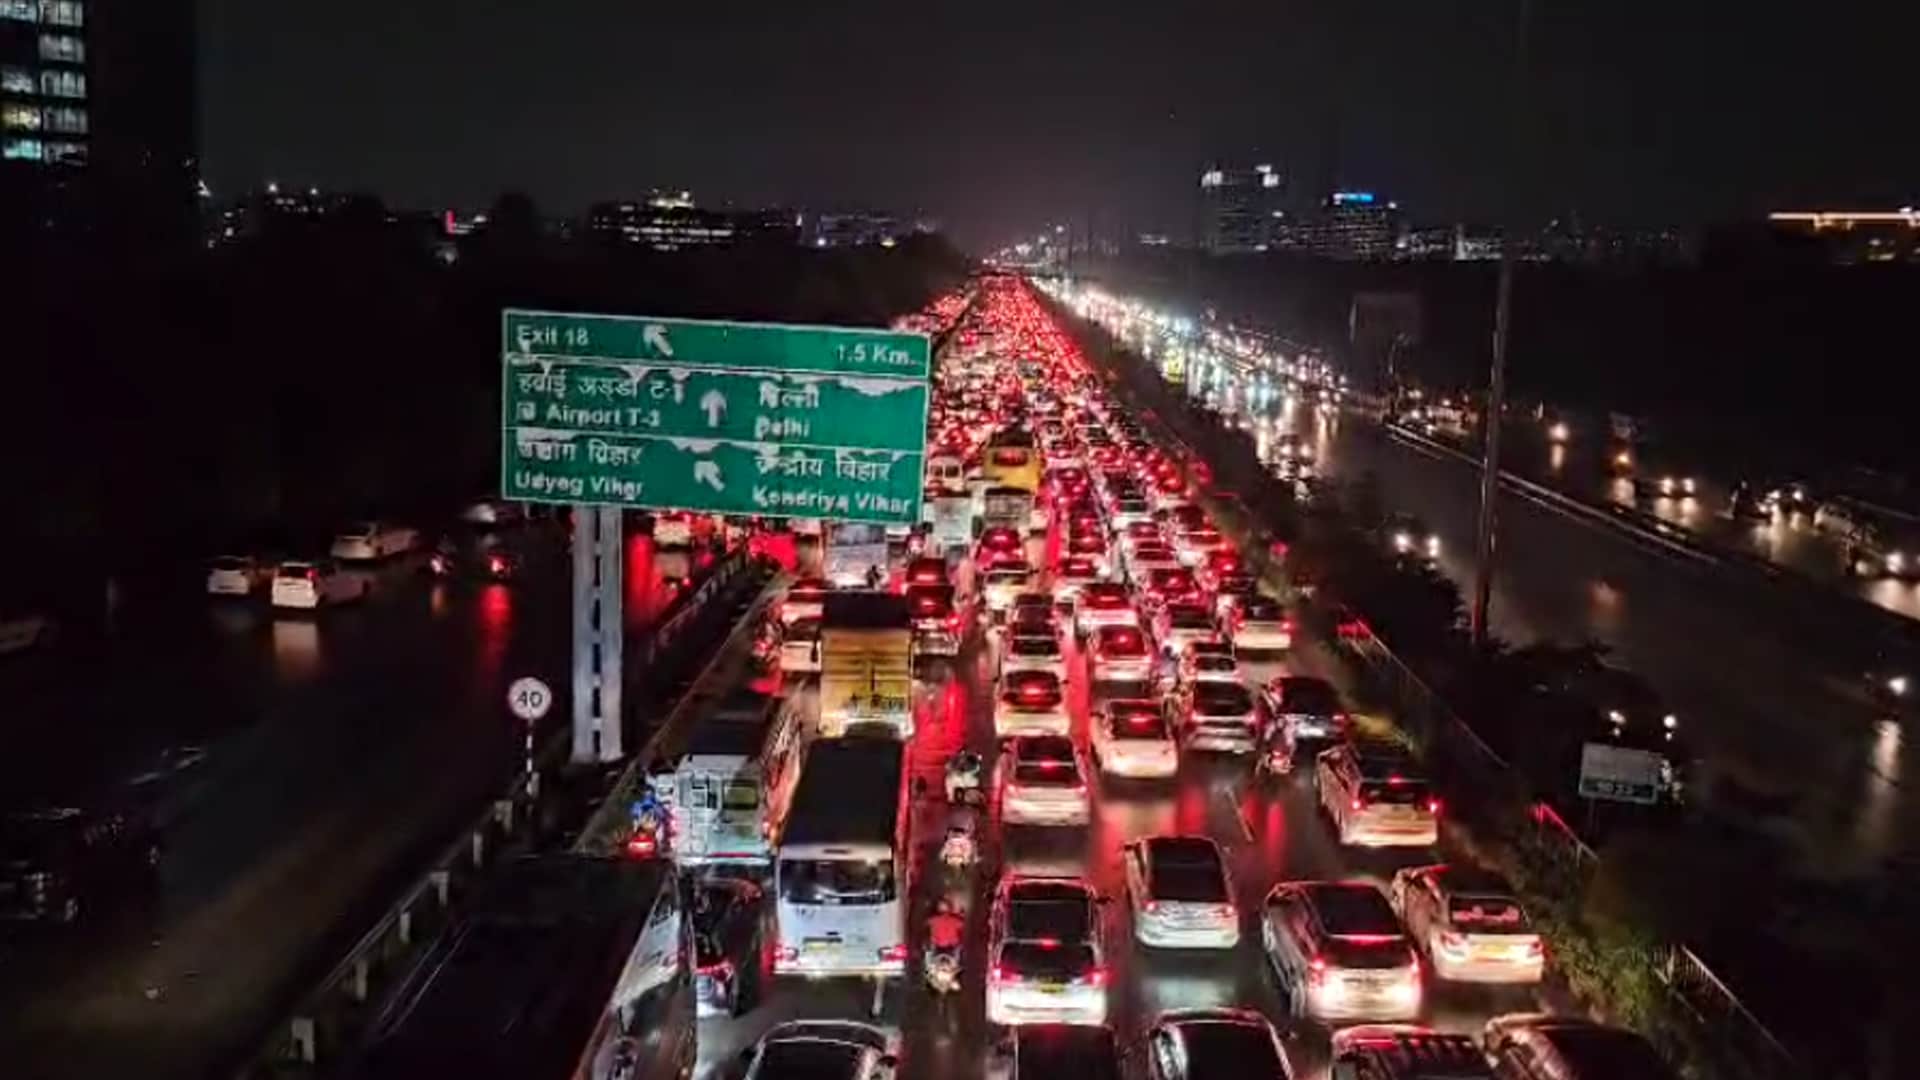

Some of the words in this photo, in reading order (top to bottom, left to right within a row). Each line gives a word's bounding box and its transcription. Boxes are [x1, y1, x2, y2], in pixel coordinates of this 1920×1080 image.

[517, 325, 557, 346] Exit
[564, 328, 589, 346] 18
[838, 343, 866, 363] 1.5
[546, 404, 621, 427] Airport
[627, 407, 660, 428] T-3
[754, 415, 811, 438] Delhi
[515, 471, 584, 496] Udyog
[589, 475, 644, 498] Vihar
[855, 491, 912, 515] Vihar
[517, 690, 543, 708] 40
